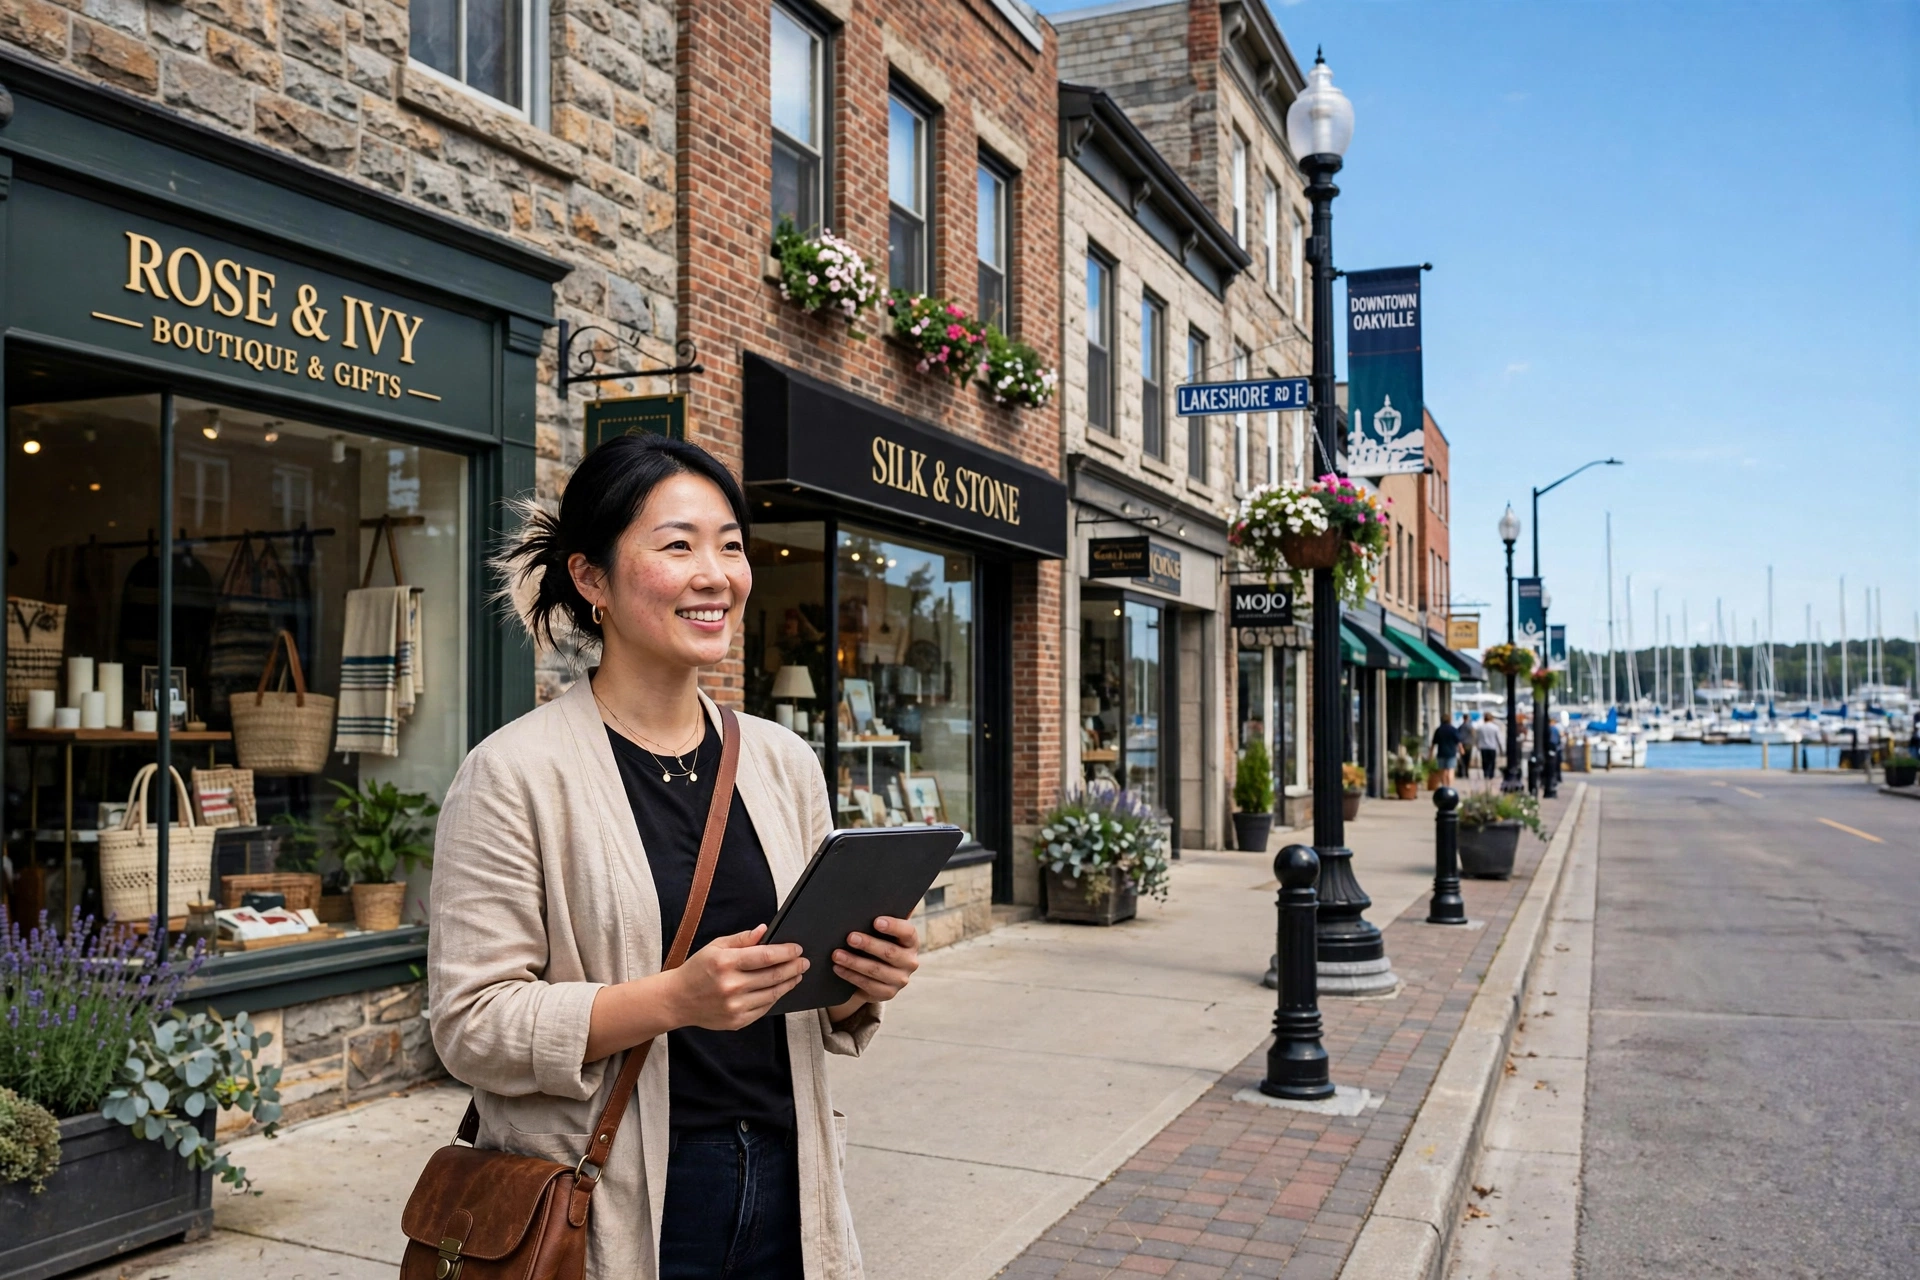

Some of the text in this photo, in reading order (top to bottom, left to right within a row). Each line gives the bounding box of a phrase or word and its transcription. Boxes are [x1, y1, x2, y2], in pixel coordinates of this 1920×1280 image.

[124, 231, 424, 364] ROSE & IVY
[1351, 293, 1417, 312] DOWNTOWN
[1353, 311, 1415, 331] OAKVILLE
[152, 315, 402, 399] BOUTIQUE & GIFTS
[1181, 383, 1304, 411] LAKESHORE RD E
[872, 436, 1020, 526] SILK & STONE
[1236, 593, 1287, 614] MOJO
